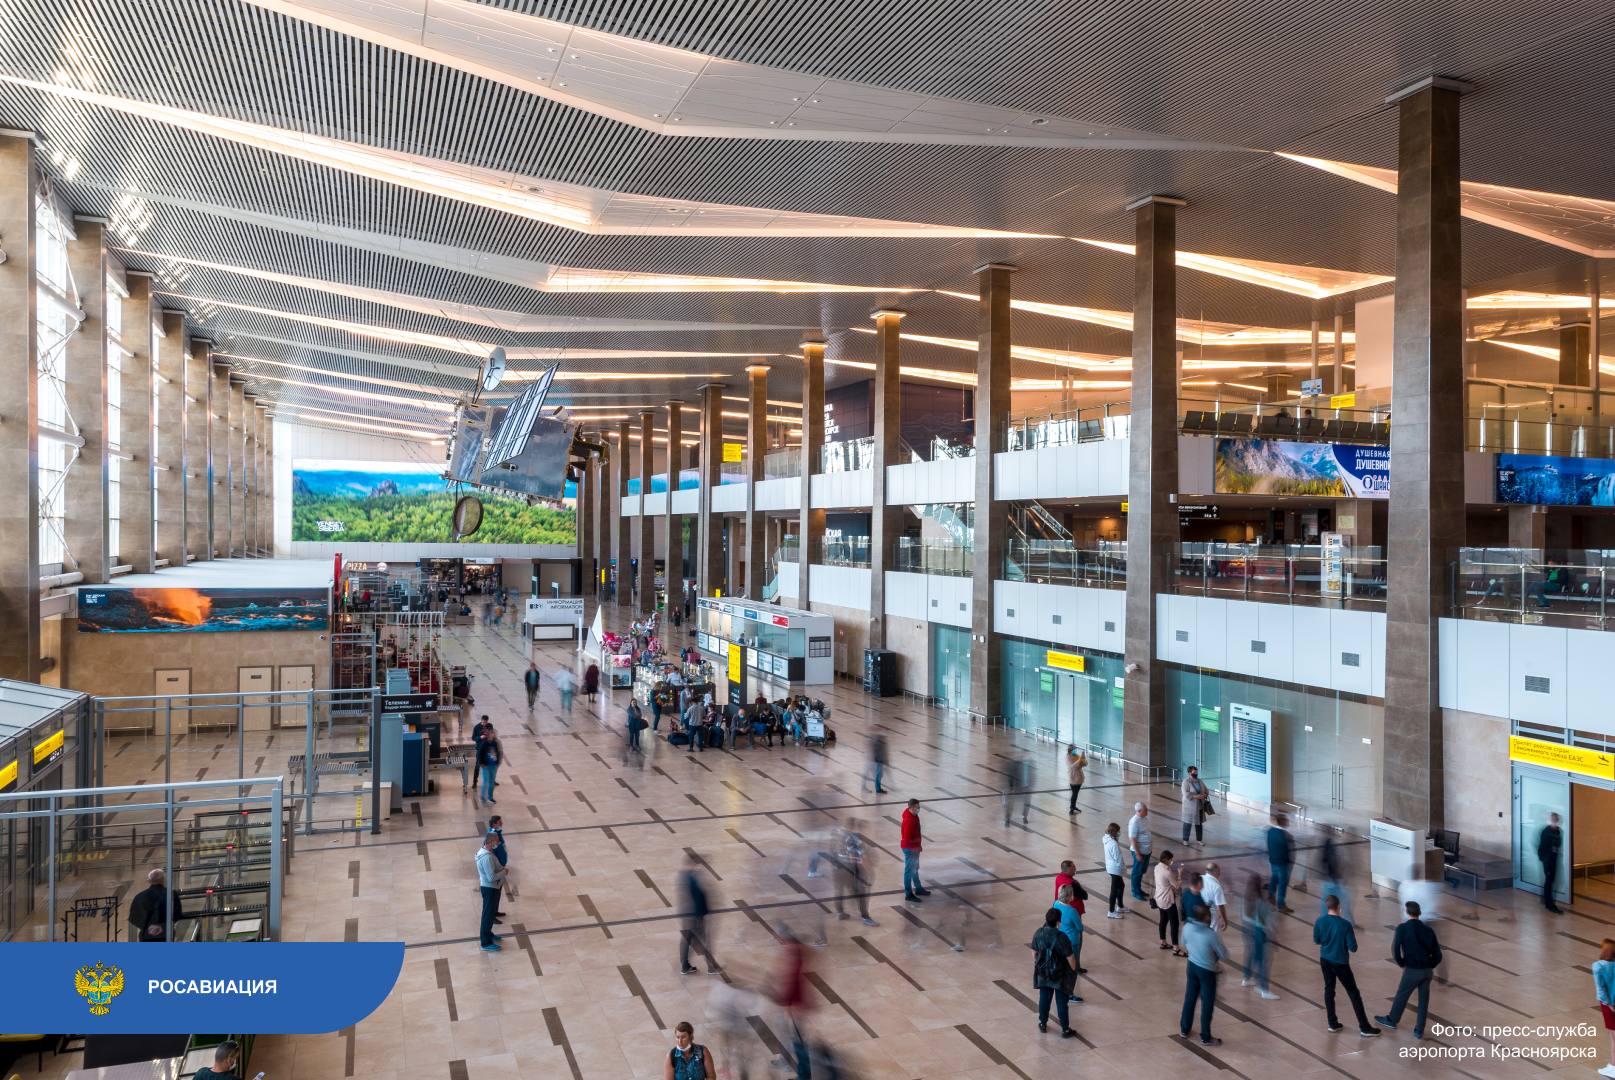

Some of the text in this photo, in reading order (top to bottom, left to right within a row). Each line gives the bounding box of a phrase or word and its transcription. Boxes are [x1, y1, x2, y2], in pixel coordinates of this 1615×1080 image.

[1355, 449, 1391, 458] ДУШЕВНАЯ
[347, 562, 368, 571] PIZZA
[1568, 754, 1584, 763] ЕАЭС
